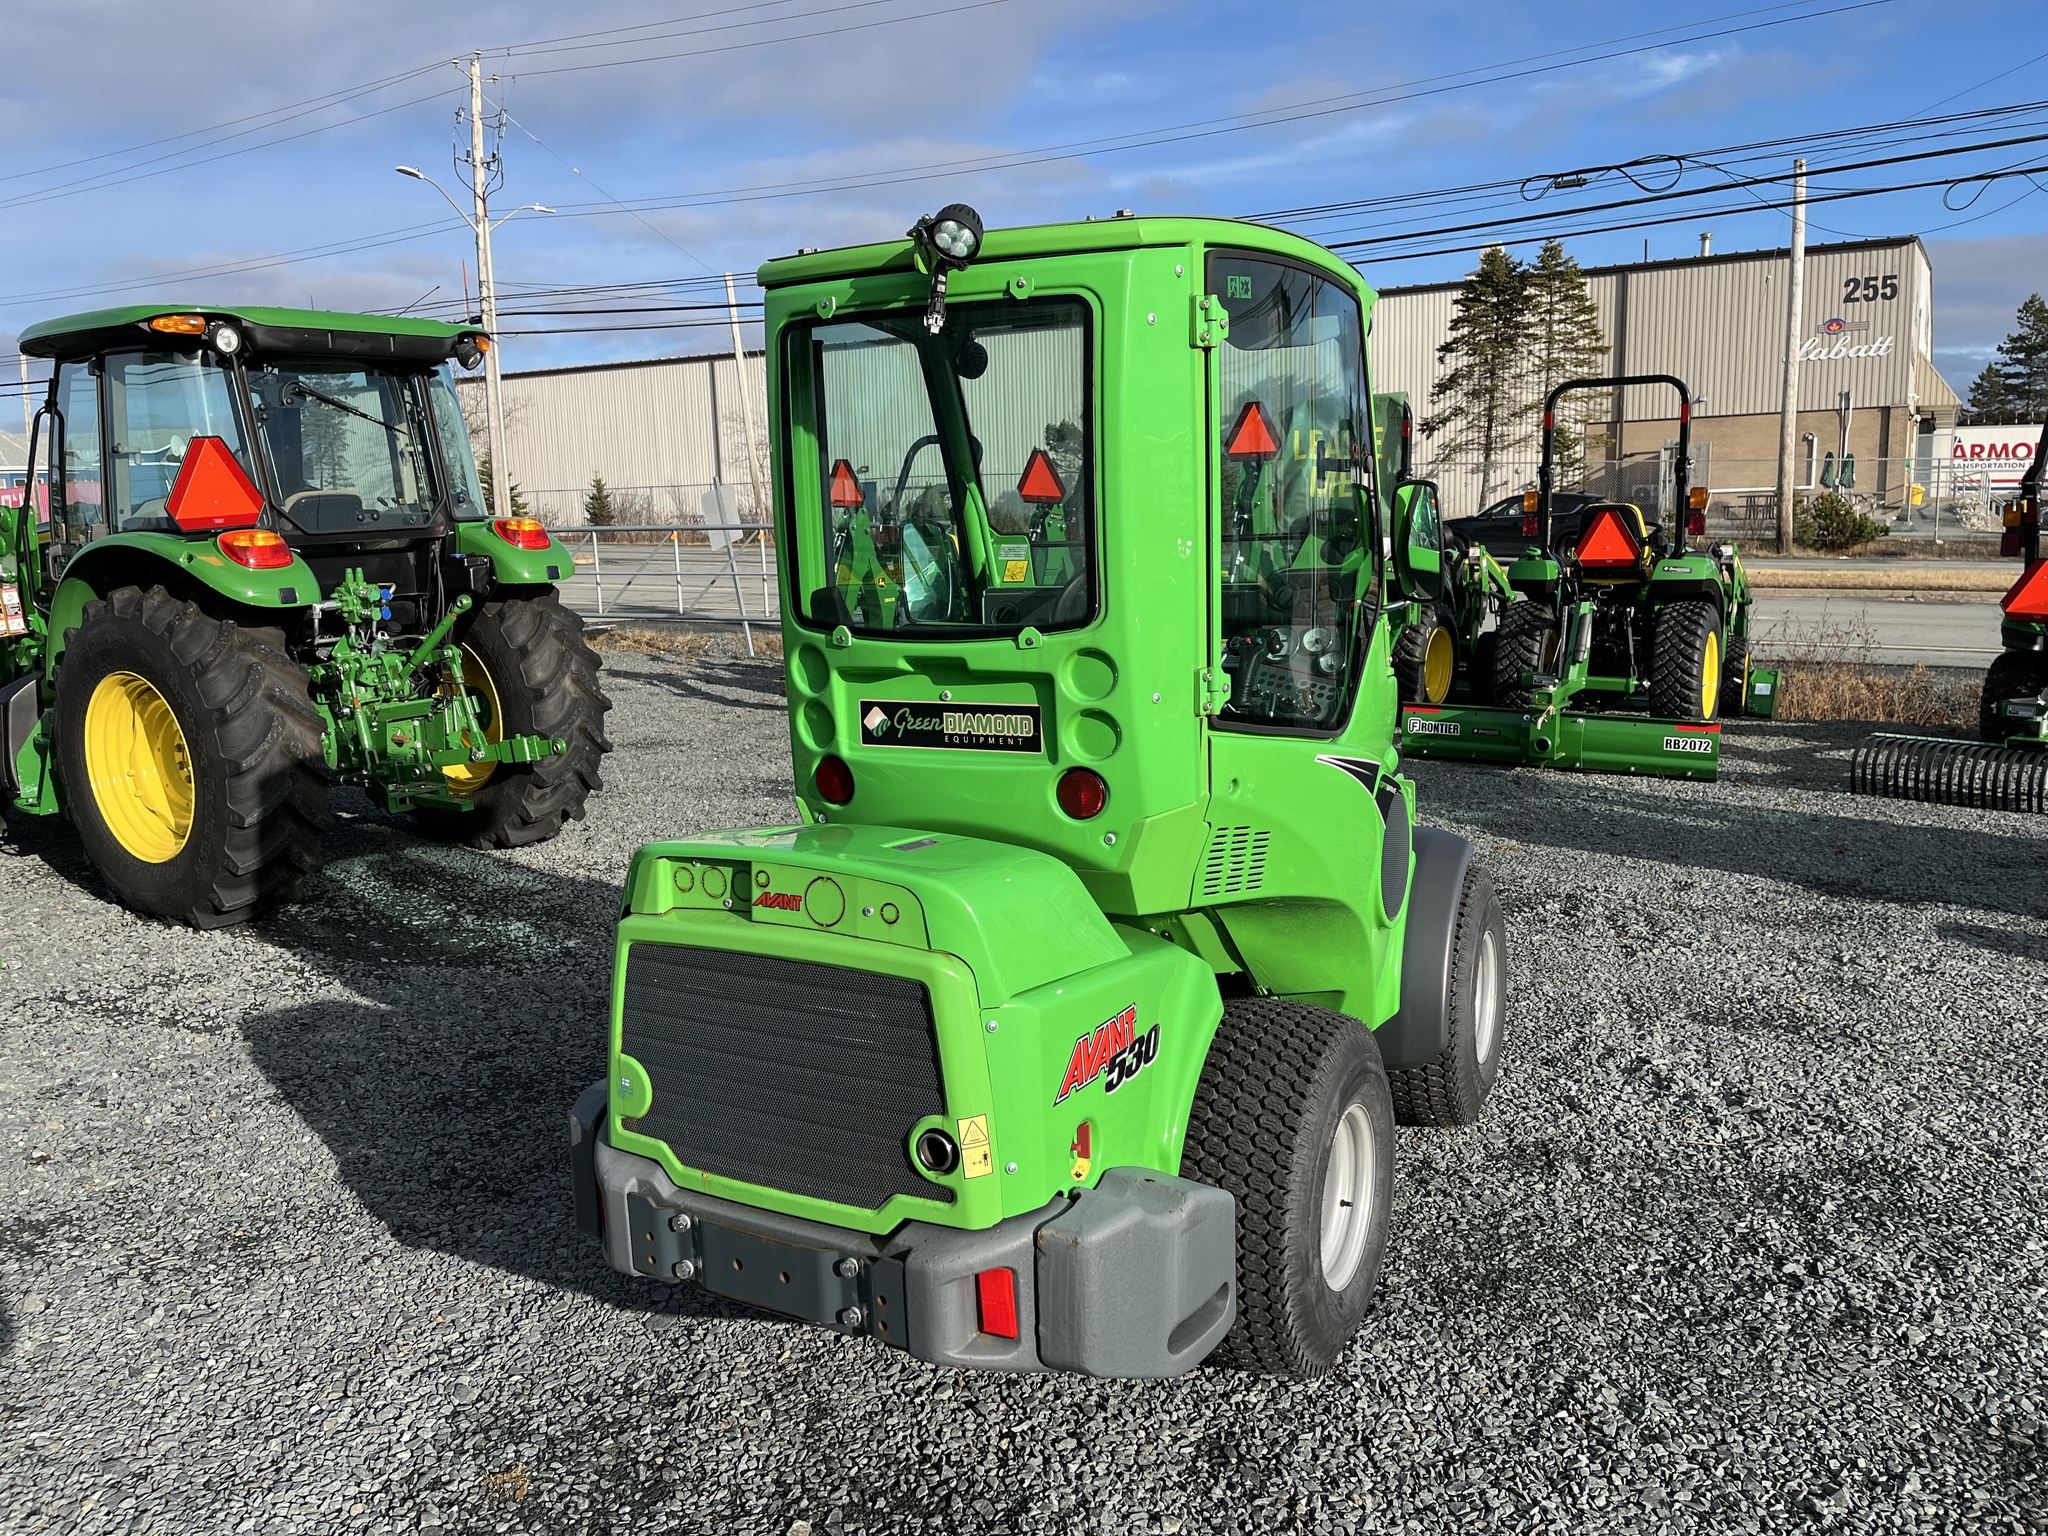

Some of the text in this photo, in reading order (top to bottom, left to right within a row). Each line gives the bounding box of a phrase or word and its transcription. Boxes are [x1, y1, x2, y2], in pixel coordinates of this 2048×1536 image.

[1843, 275, 1898, 303] 255
[1953, 442, 2040, 462] ARMO
[894, 707, 1033, 738] Green DIAMOND
[1408, 717, 1460, 735] FRONTIER
[945, 735, 1024, 746] EQUIPMENT
[1664, 737, 1711, 753] RB2072
[752, 891, 802, 912] AVANT
[1053, 1002, 1161, 1107] AVANT 530
